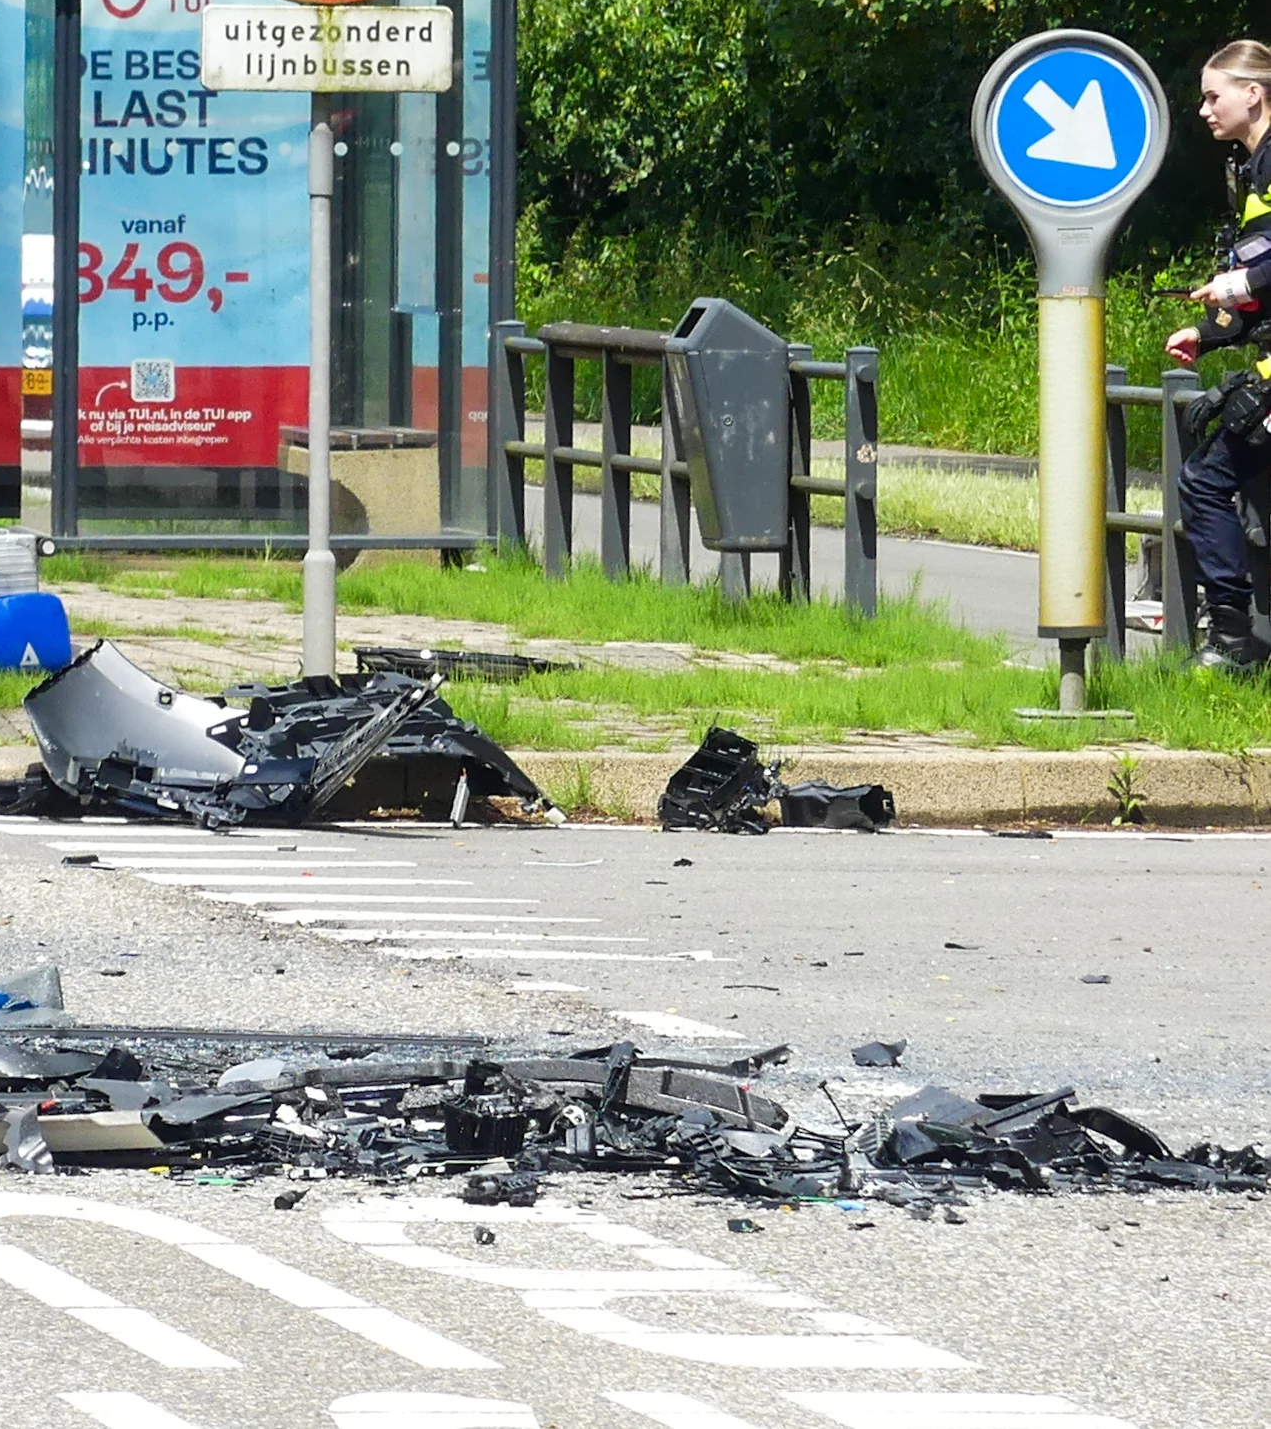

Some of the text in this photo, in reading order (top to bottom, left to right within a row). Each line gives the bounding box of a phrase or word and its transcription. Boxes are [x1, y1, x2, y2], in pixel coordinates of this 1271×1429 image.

[224, 19, 434, 48] uitgezonderd
[125, 49, 201, 81] BES
[245, 53, 412, 83] lijnbussen
[93, 89, 218, 128] LAST
[79, 136, 270, 177] INUTES
[121, 214, 187, 234] vanaf
[132, 311, 175, 333] p.p.
[88, 411, 106, 420] nu
[107, 409, 126, 420] via
[170, 408, 182, 420] in
[183, 408, 200, 420] de
[202, 408, 225, 420] TUI
[226, 410, 252, 423] app
[89, 419, 216, 434] of bij je reisadviseur
